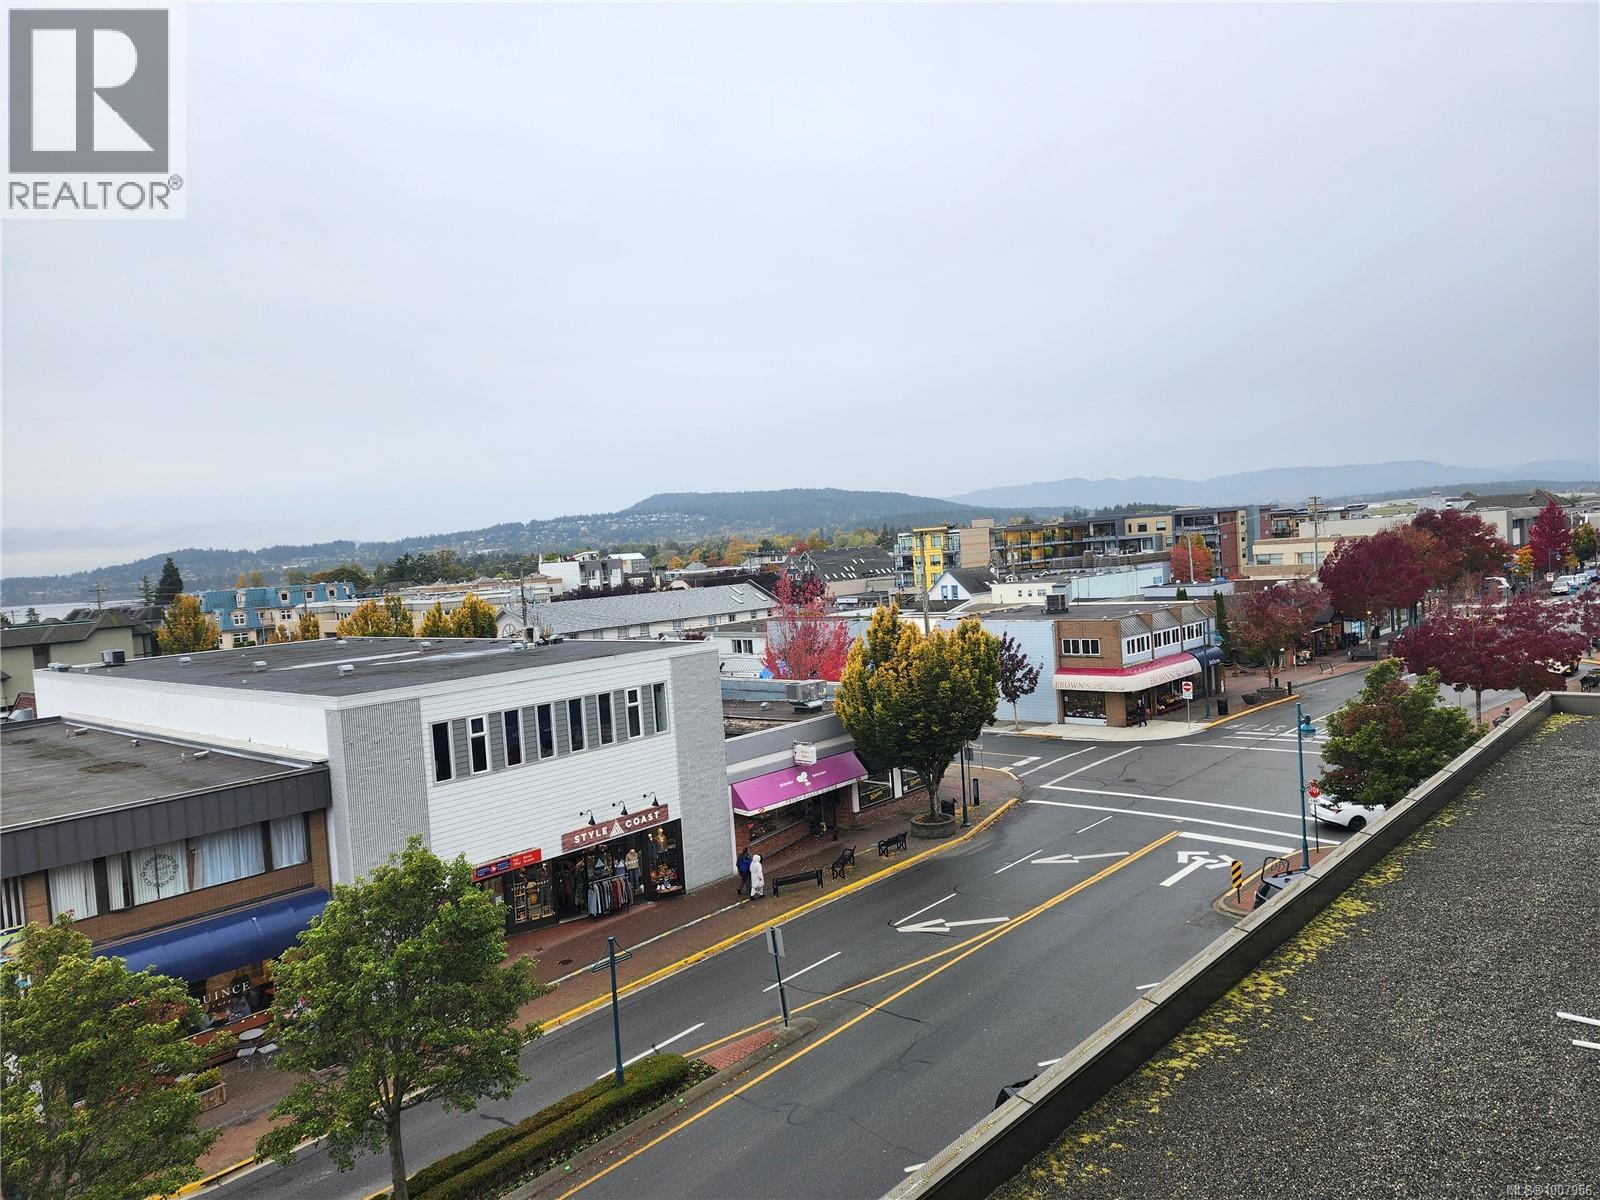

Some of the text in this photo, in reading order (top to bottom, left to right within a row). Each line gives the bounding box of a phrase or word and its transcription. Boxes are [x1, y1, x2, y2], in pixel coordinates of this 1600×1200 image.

[574, 811, 660, 844] STYLE COAST
[203, 981, 251, 1004] UINCE
